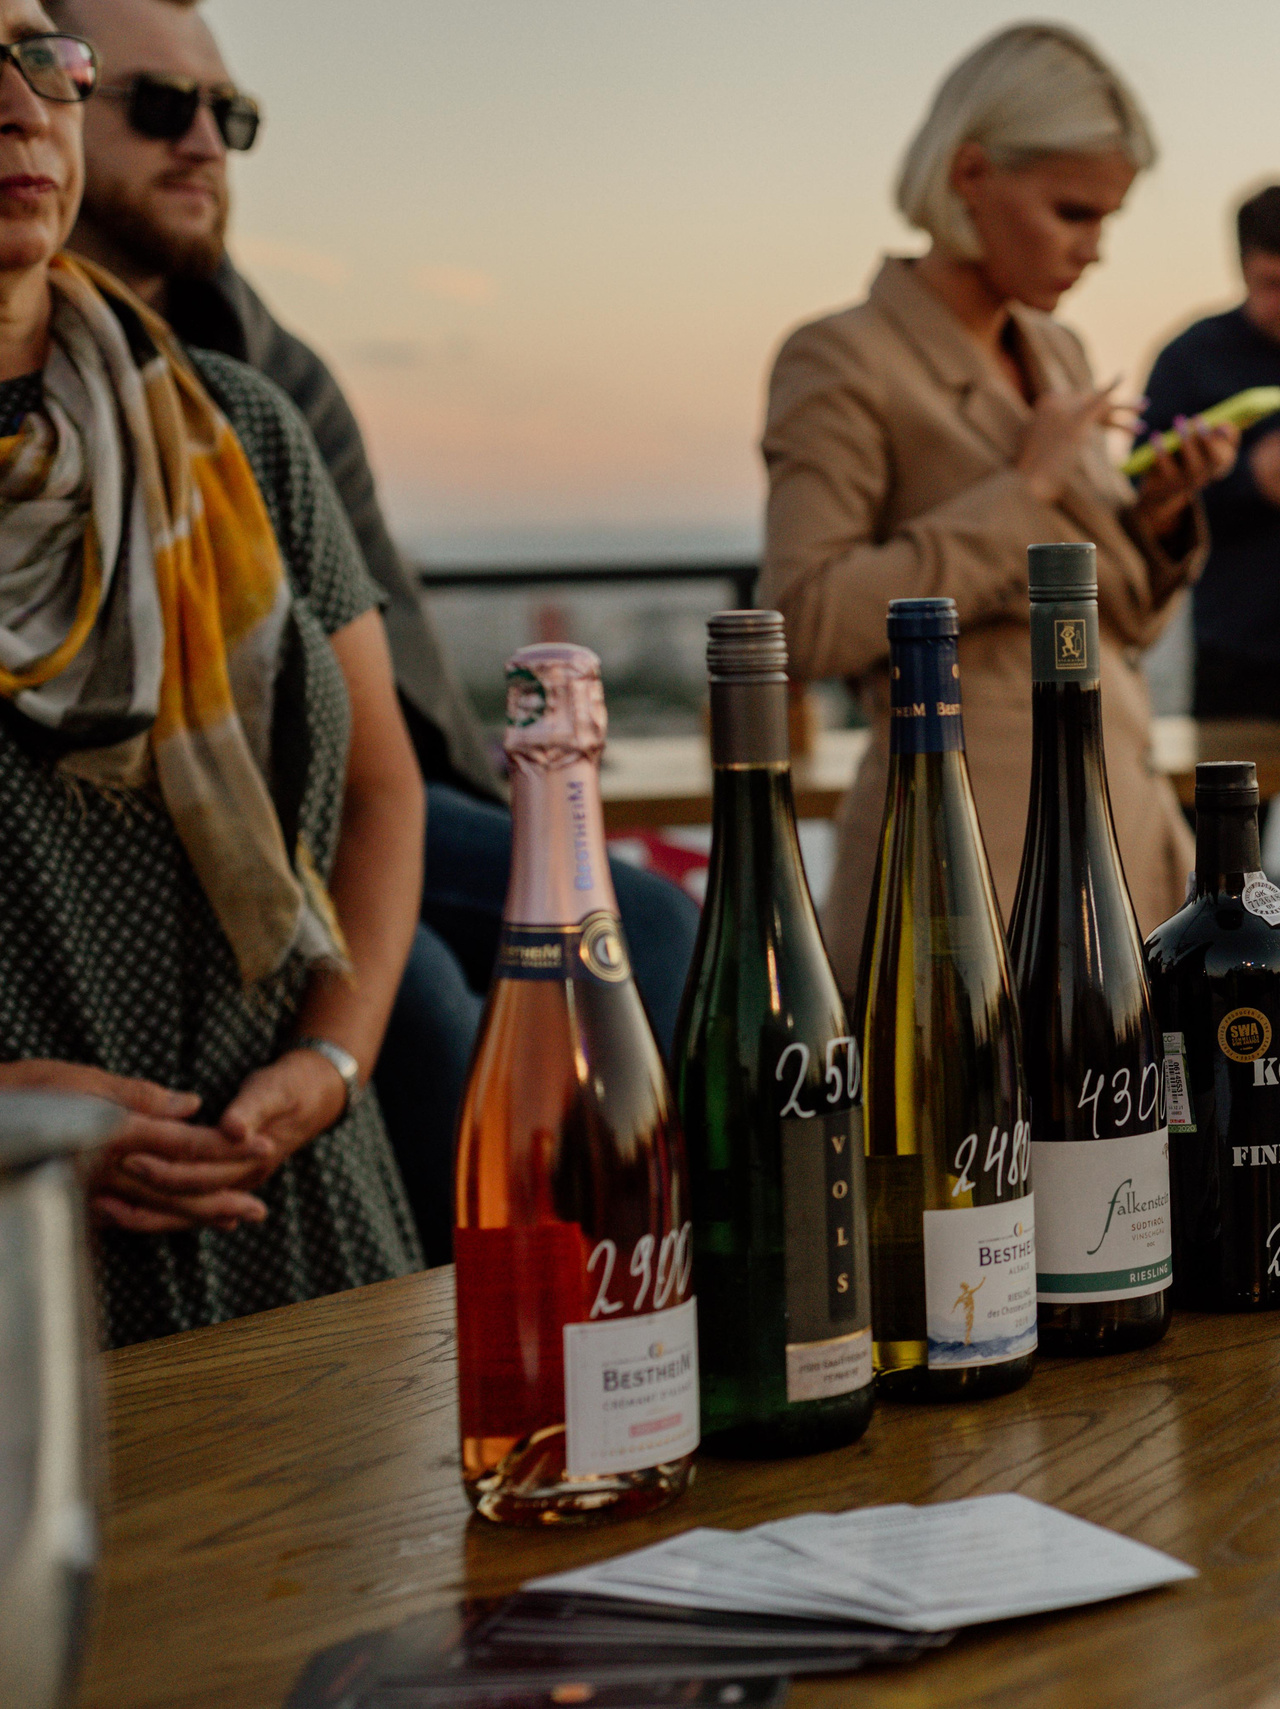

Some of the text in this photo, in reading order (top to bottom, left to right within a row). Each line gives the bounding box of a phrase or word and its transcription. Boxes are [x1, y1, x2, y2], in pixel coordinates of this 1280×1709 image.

[1231, 1022, 1259, 1038] SWA
[832, 1136, 849, 1293] VOLS
[1131, 1216, 1165, 1232] SÜDTIROL
[587, 1220, 692, 1319] 2900
[1129, 1263, 1169, 1284] RIESLING
[603, 1352, 692, 1393] BESTHEIM
